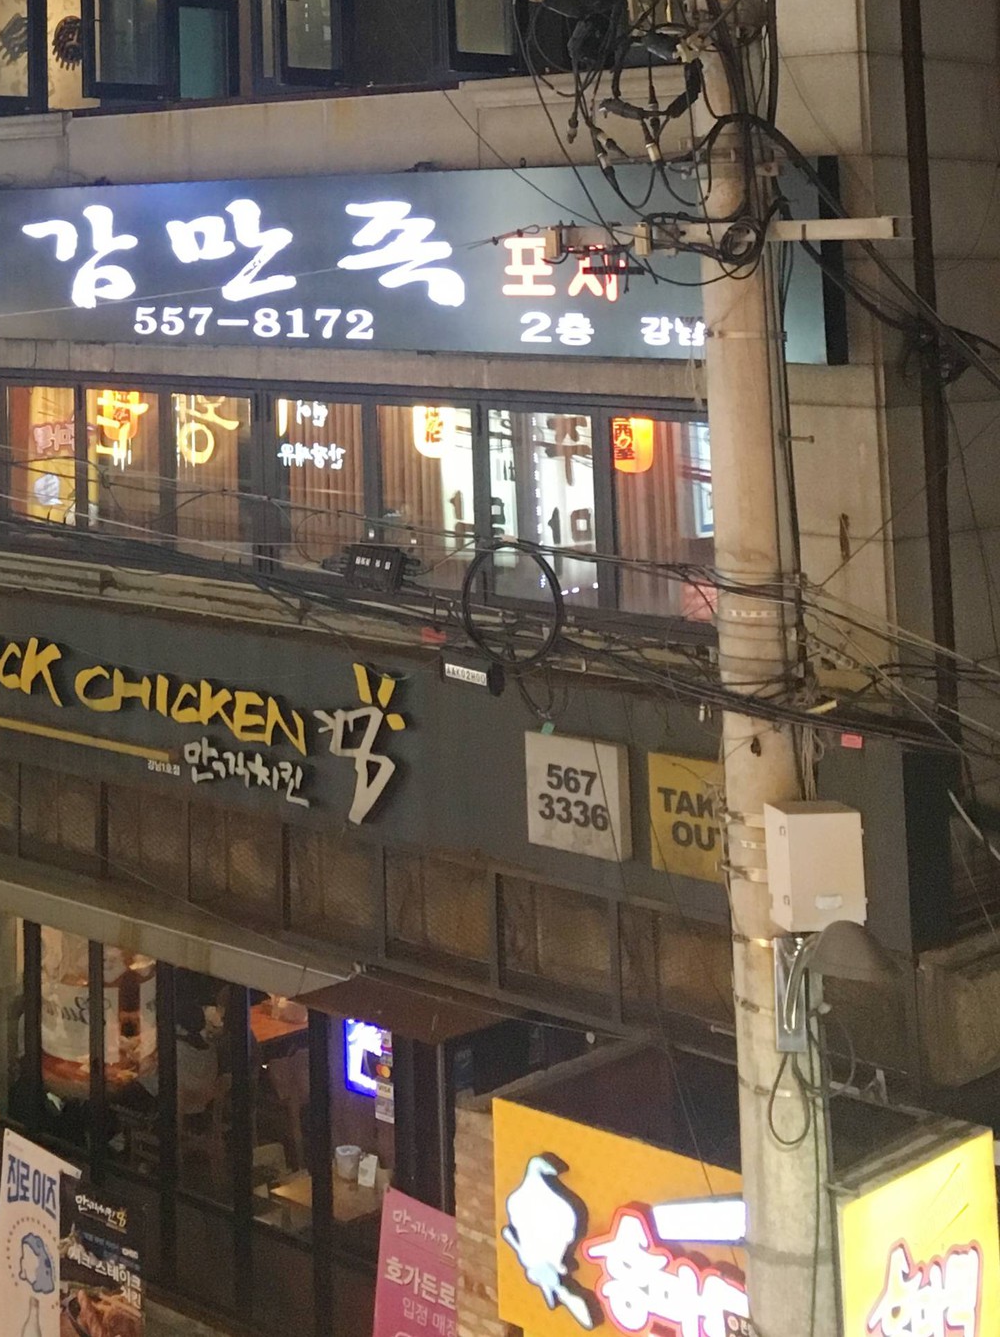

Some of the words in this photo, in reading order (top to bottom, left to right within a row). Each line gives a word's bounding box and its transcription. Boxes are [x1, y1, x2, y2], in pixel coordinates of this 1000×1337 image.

[133, 306, 376, 341] 557-8172
[520, 312, 595, 347] 2층
[74, 665, 306, 755] CHICKEN
[546, 763, 598, 796] 567
[538, 793, 609, 832] 3336
[657, 787, 714, 820] TAK
[402, 1297, 429, 1327] 입점
